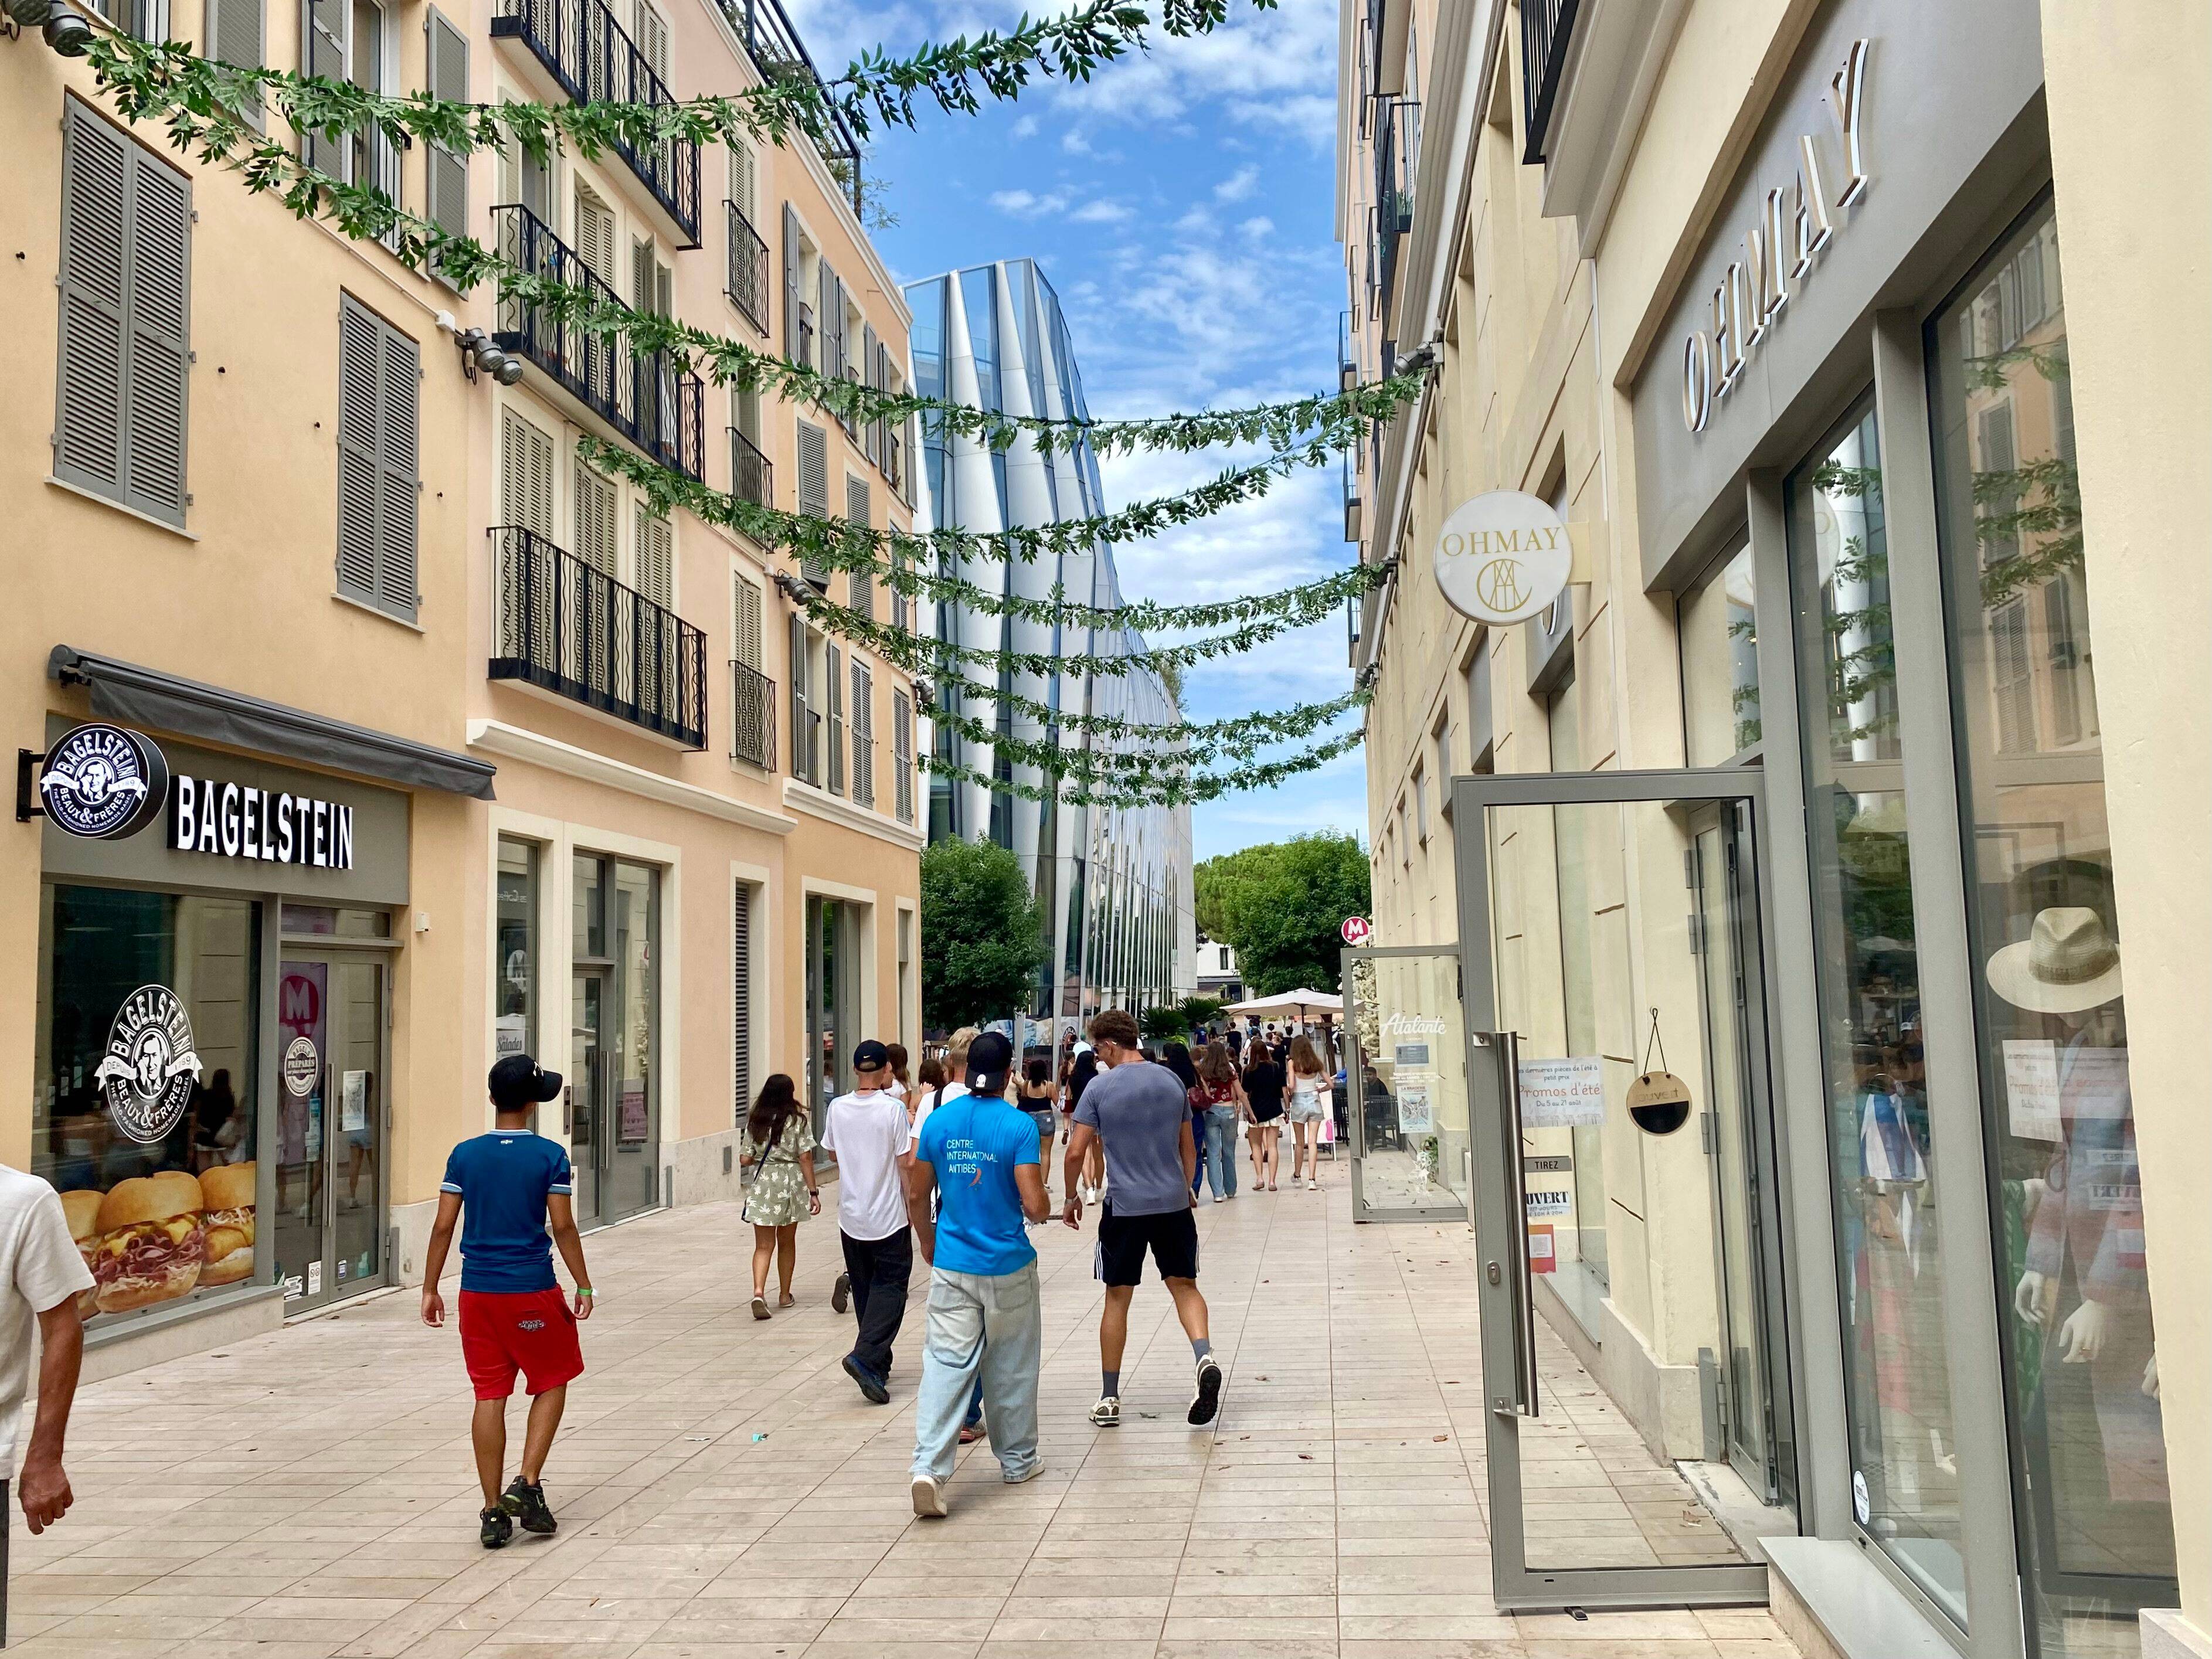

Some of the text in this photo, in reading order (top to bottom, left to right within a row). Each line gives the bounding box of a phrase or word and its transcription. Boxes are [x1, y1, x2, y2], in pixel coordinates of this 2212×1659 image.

[1682, 38, 1870, 433] OHMAY
[1442, 527, 1561, 556] OHMAY
[56, 732, 136, 779] BAGELSTEIN
[60, 787, 81, 820] BEAUX
[94, 791, 125, 822] FRÈRES
[178, 774, 353, 869] BAGELSTEIN
[111, 991, 191, 1057] BAGELSTEIN
[1380, 1012, 1447, 1037] Atalante
[497, 1036, 522, 1052] Salades
[107, 1061, 131, 1076] DEPUIS
[117, 1078, 141, 1124] BEAUX
[155, 1075, 183, 1124] FRÈRES
[1571, 1082, 1601, 1096] d'été
[947, 1140, 974, 1149] CENTRE
[949, 1164, 976, 1174] ANTIBES
[1534, 1161, 1558, 1170] TIREZ
[1526, 1191, 1569, 1205] UVERT
